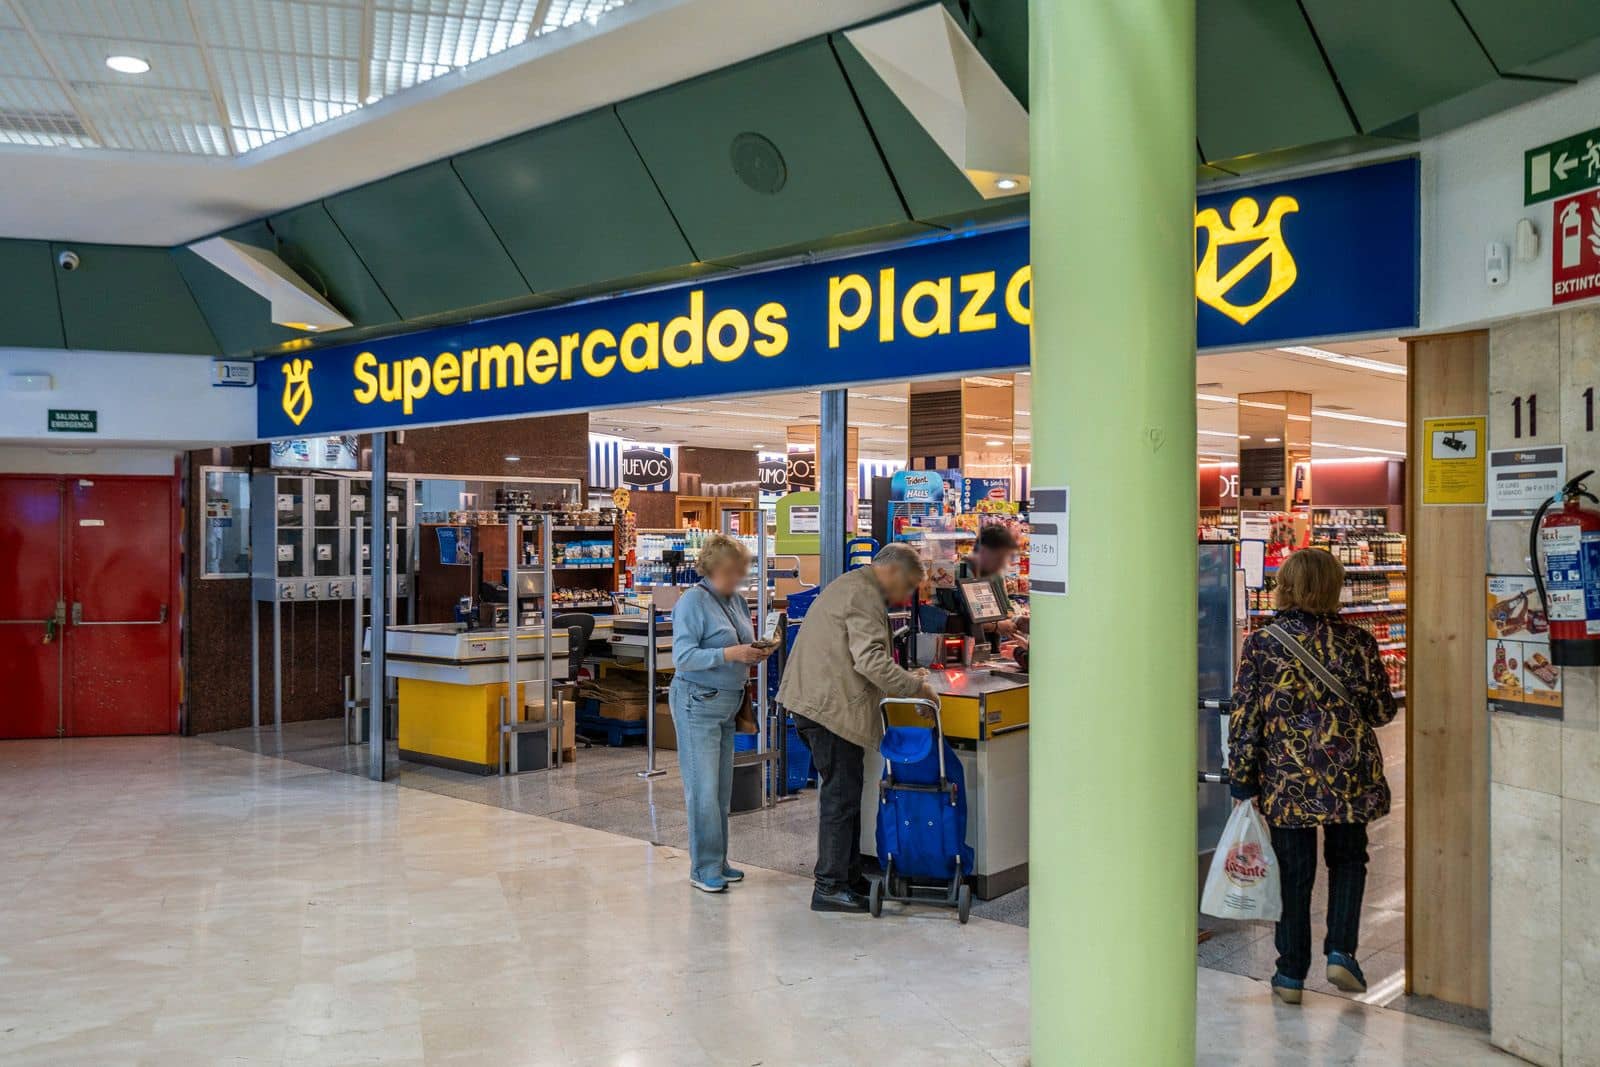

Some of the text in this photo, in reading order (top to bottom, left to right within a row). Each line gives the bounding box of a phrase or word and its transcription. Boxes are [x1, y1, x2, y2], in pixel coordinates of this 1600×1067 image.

[353, 290, 789, 414] Supermercados
[1512, 393, 1537, 438] 11
[758, 468, 788, 485] UMO
[1041, 543, 1048, 554] 15
